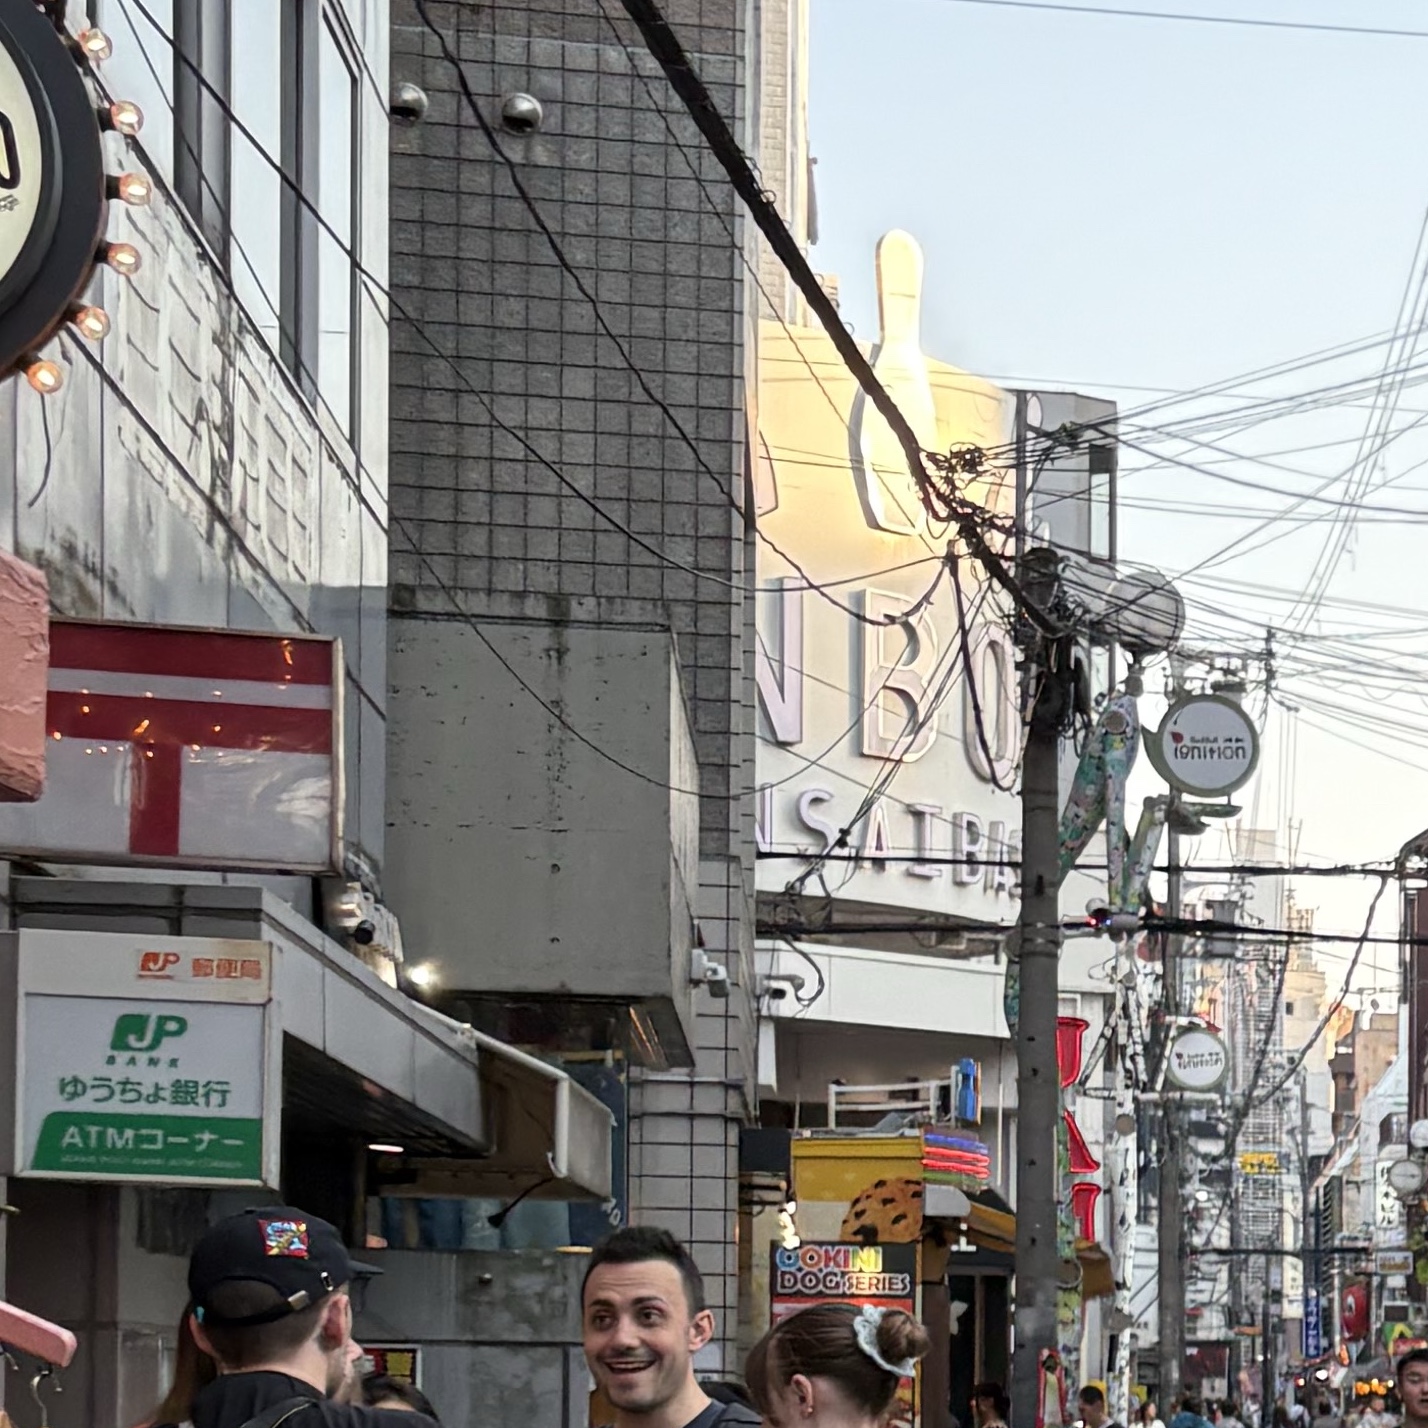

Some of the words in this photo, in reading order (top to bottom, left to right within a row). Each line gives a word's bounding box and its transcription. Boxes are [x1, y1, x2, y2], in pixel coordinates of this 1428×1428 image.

[110, 1013, 189, 1052] JP
[58, 1076, 232, 1108] ゆうちょ銀行
[61, 1126, 245, 1152] ATMコーナー
[777, 1270, 843, 1293] DOG
[845, 1273, 911, 1294] SERIES
